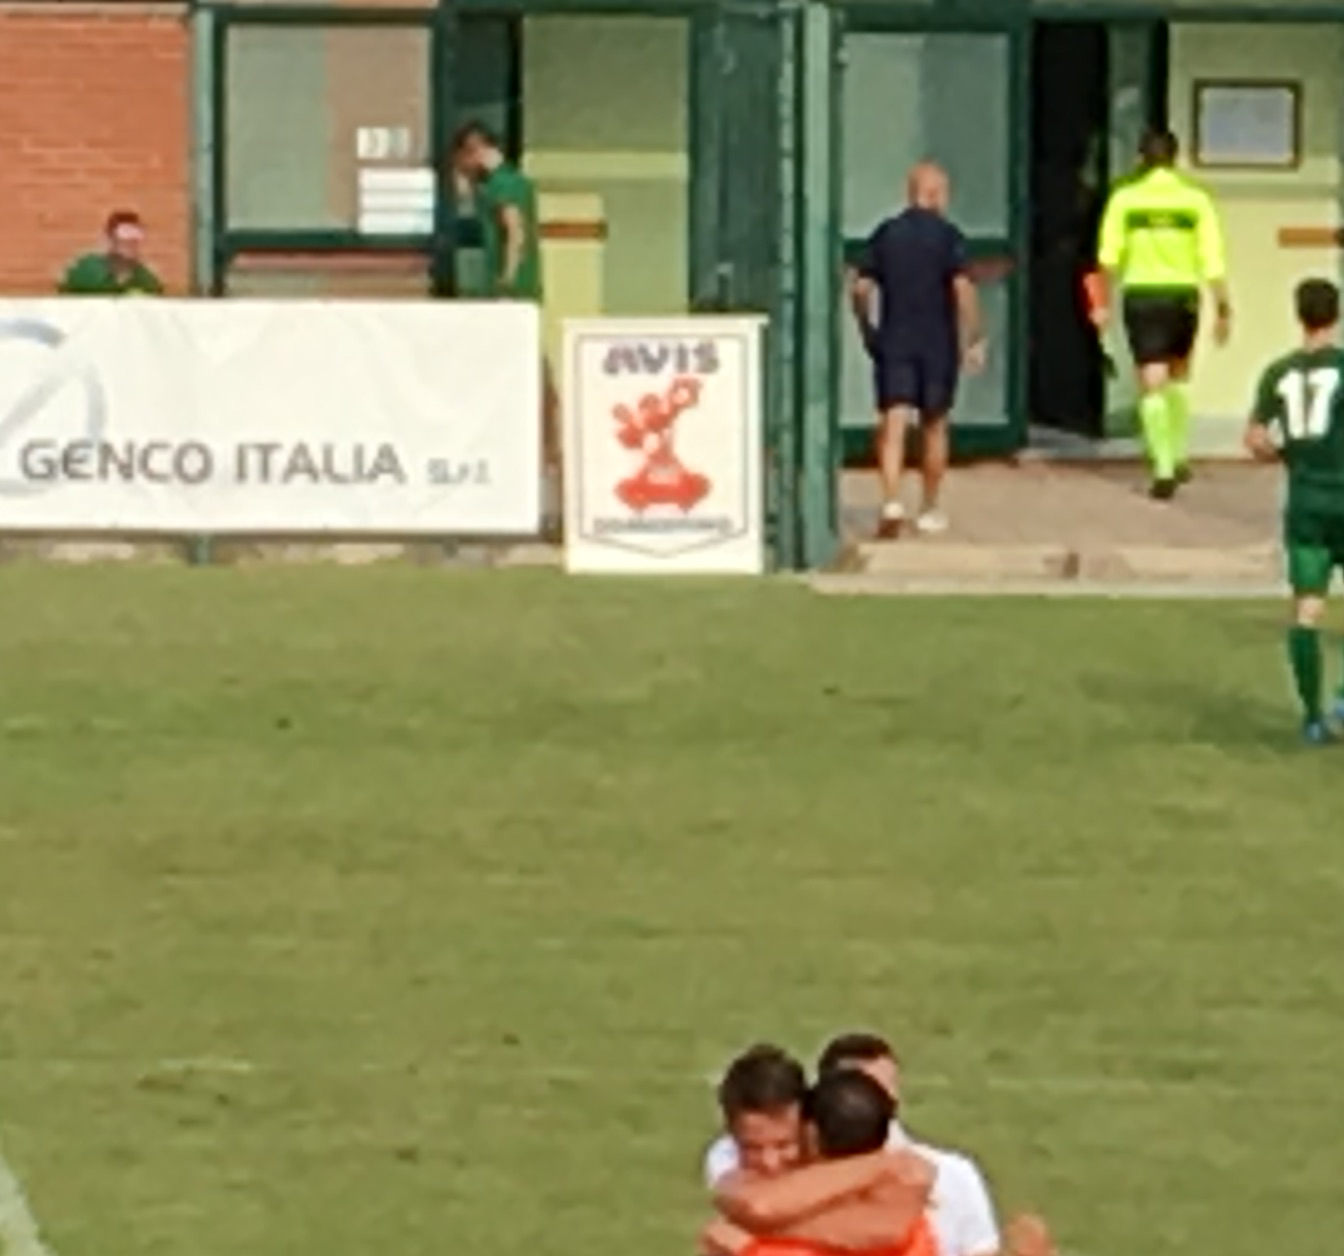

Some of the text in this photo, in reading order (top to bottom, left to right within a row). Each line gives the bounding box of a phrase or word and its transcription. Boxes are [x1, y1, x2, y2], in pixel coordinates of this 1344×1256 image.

[603, 343, 720, 376] AVIS
[1277, 368, 1340, 439] 17
[18, 440, 214, 485] GENCO
[234, 441, 406, 485] ITALIA
